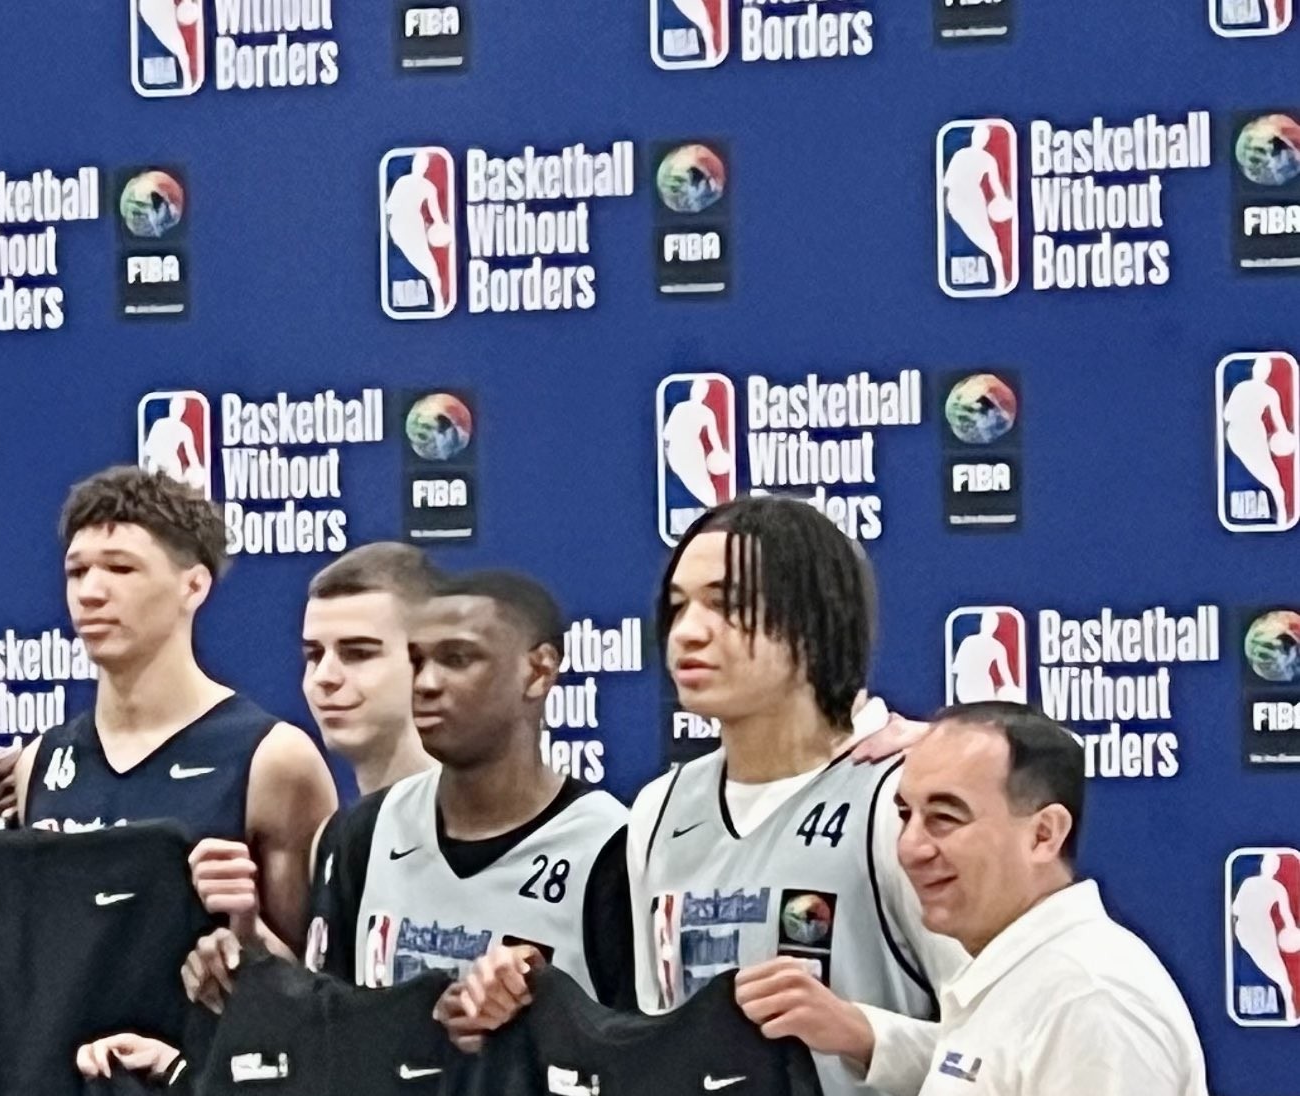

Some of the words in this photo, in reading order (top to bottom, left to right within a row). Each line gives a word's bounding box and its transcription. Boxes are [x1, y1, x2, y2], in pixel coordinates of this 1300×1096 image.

[216, 0, 333, 35] Without
[405, 7, 459, 36] FIBA
[742, 3, 872, 61] Borders
[216, 34, 338, 90] Borders
[1031, 112, 1210, 175] Basketball
[467, 141, 633, 202] Basketball
[467, 202, 589, 257] Without
[1031, 175, 1162, 232] Without
[128, 256, 179, 283] FIBA
[664, 233, 720, 261] FIBA
[1033, 232, 1169, 289] Borders
[469, 257, 595, 312] Borders
[222, 389, 383, 446] Basketball
[748, 370, 920, 430] Basketball
[222, 447, 340, 500] Without
[748, 431, 875, 486] Without
[953, 464, 1010, 491] FIBA
[413, 479, 466, 507] FIBA
[225, 499, 347, 555] Borders
[559, 617, 643, 673] tball
[1040, 606, 1218, 664] Basketball
[1039, 665, 1171, 721] Without
[44, 746, 75, 790] 46
[1073, 723, 1179, 778] rders
[796, 800, 850, 847] 44
[519, 854, 569, 903] 28
